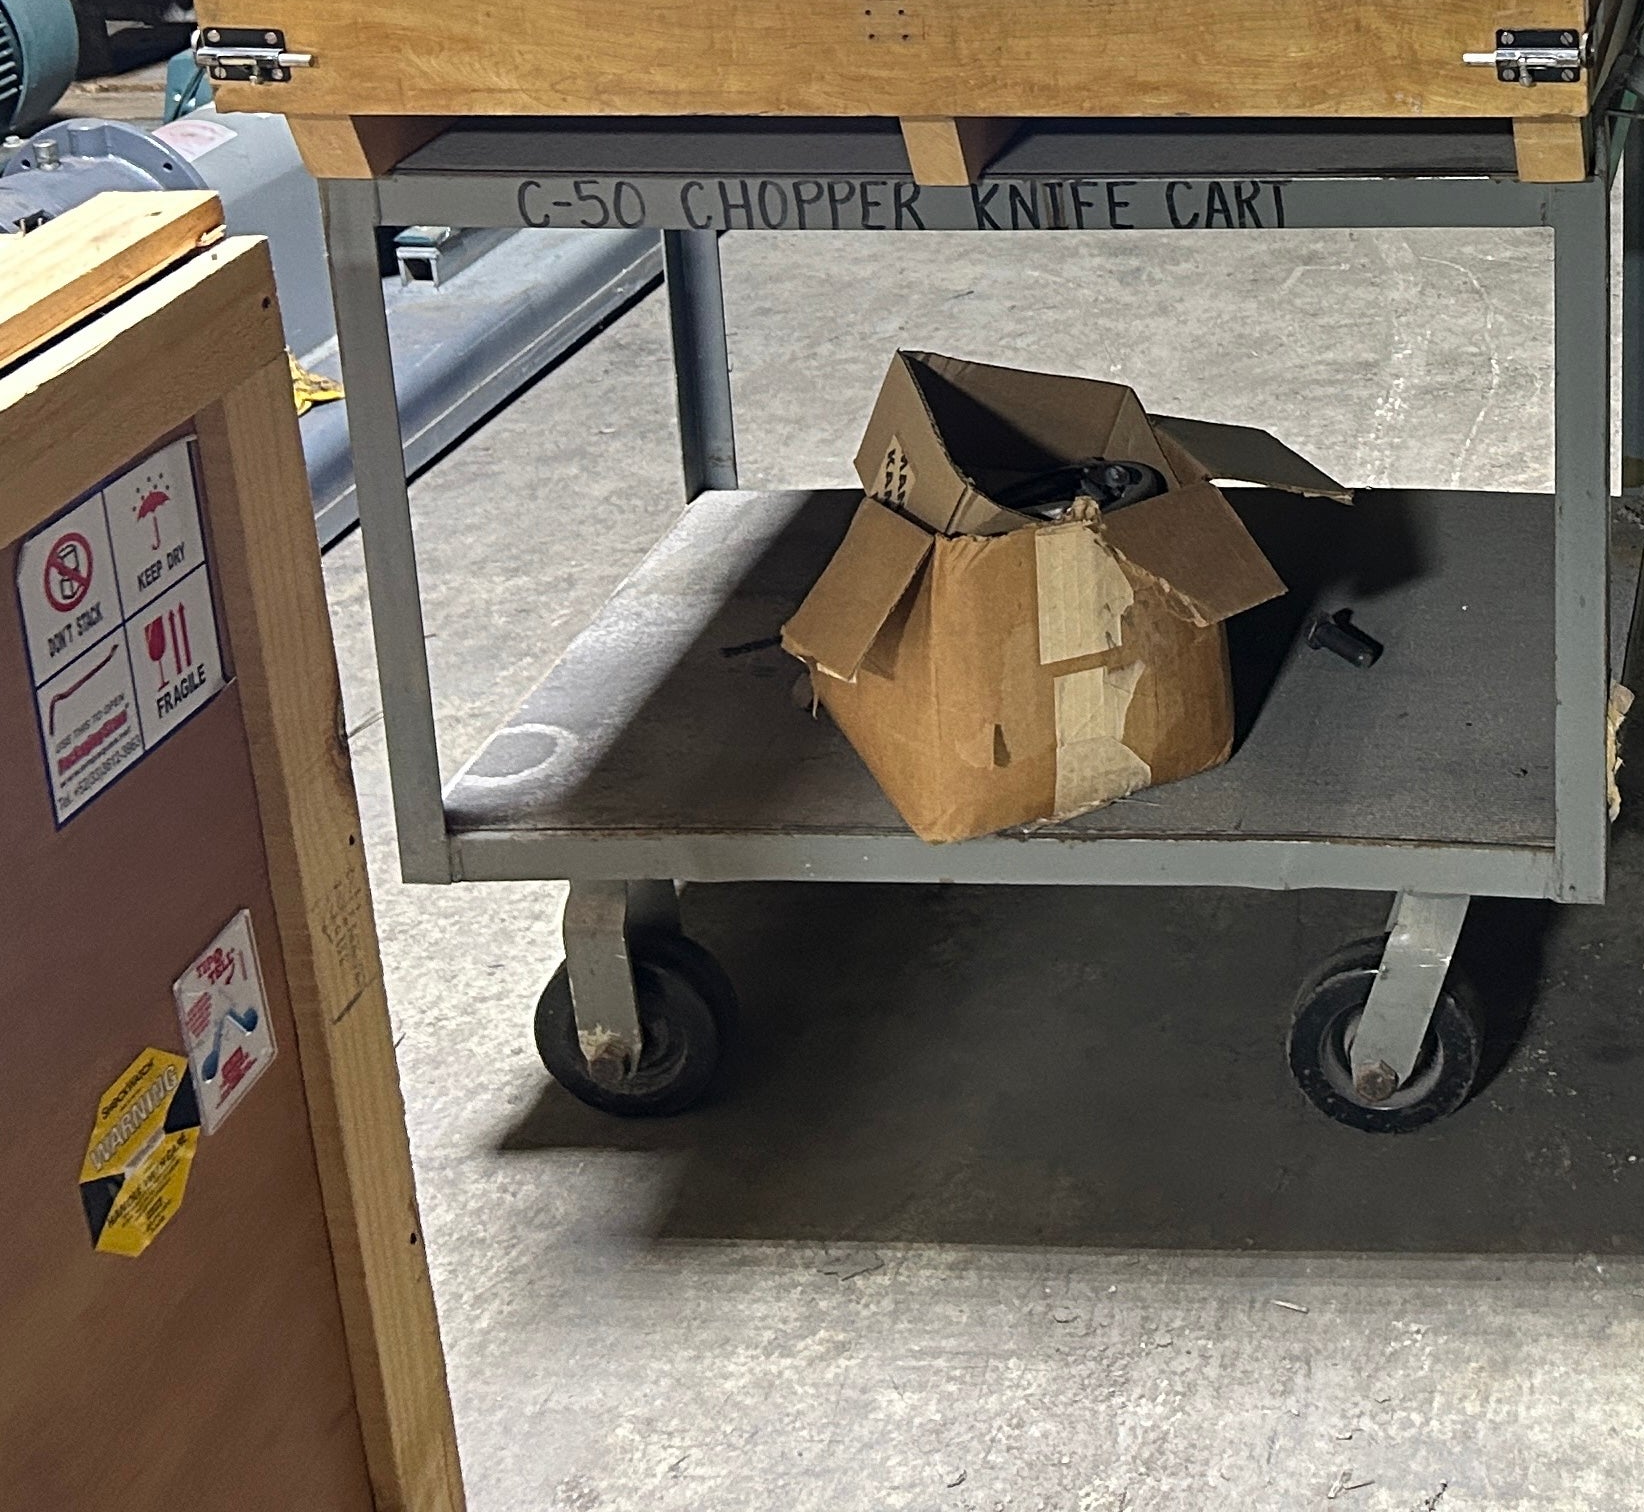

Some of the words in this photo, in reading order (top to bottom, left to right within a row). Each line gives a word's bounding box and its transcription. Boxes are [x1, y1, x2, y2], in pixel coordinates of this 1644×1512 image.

[517, 181, 646, 229] C-50
[681, 180, 924, 231] CHOPPER
[970, 180, 1137, 230] KNIFE
[1165, 179, 1294, 230] CART
[136, 560, 163, 592] KEEP
[166, 542, 186, 571] DRY
[47, 620, 73, 658] DON'T
[76, 602, 104, 636] STACK
[156, 663, 207, 719] FRAGILE
[89, 1063, 179, 1171] WARNING
